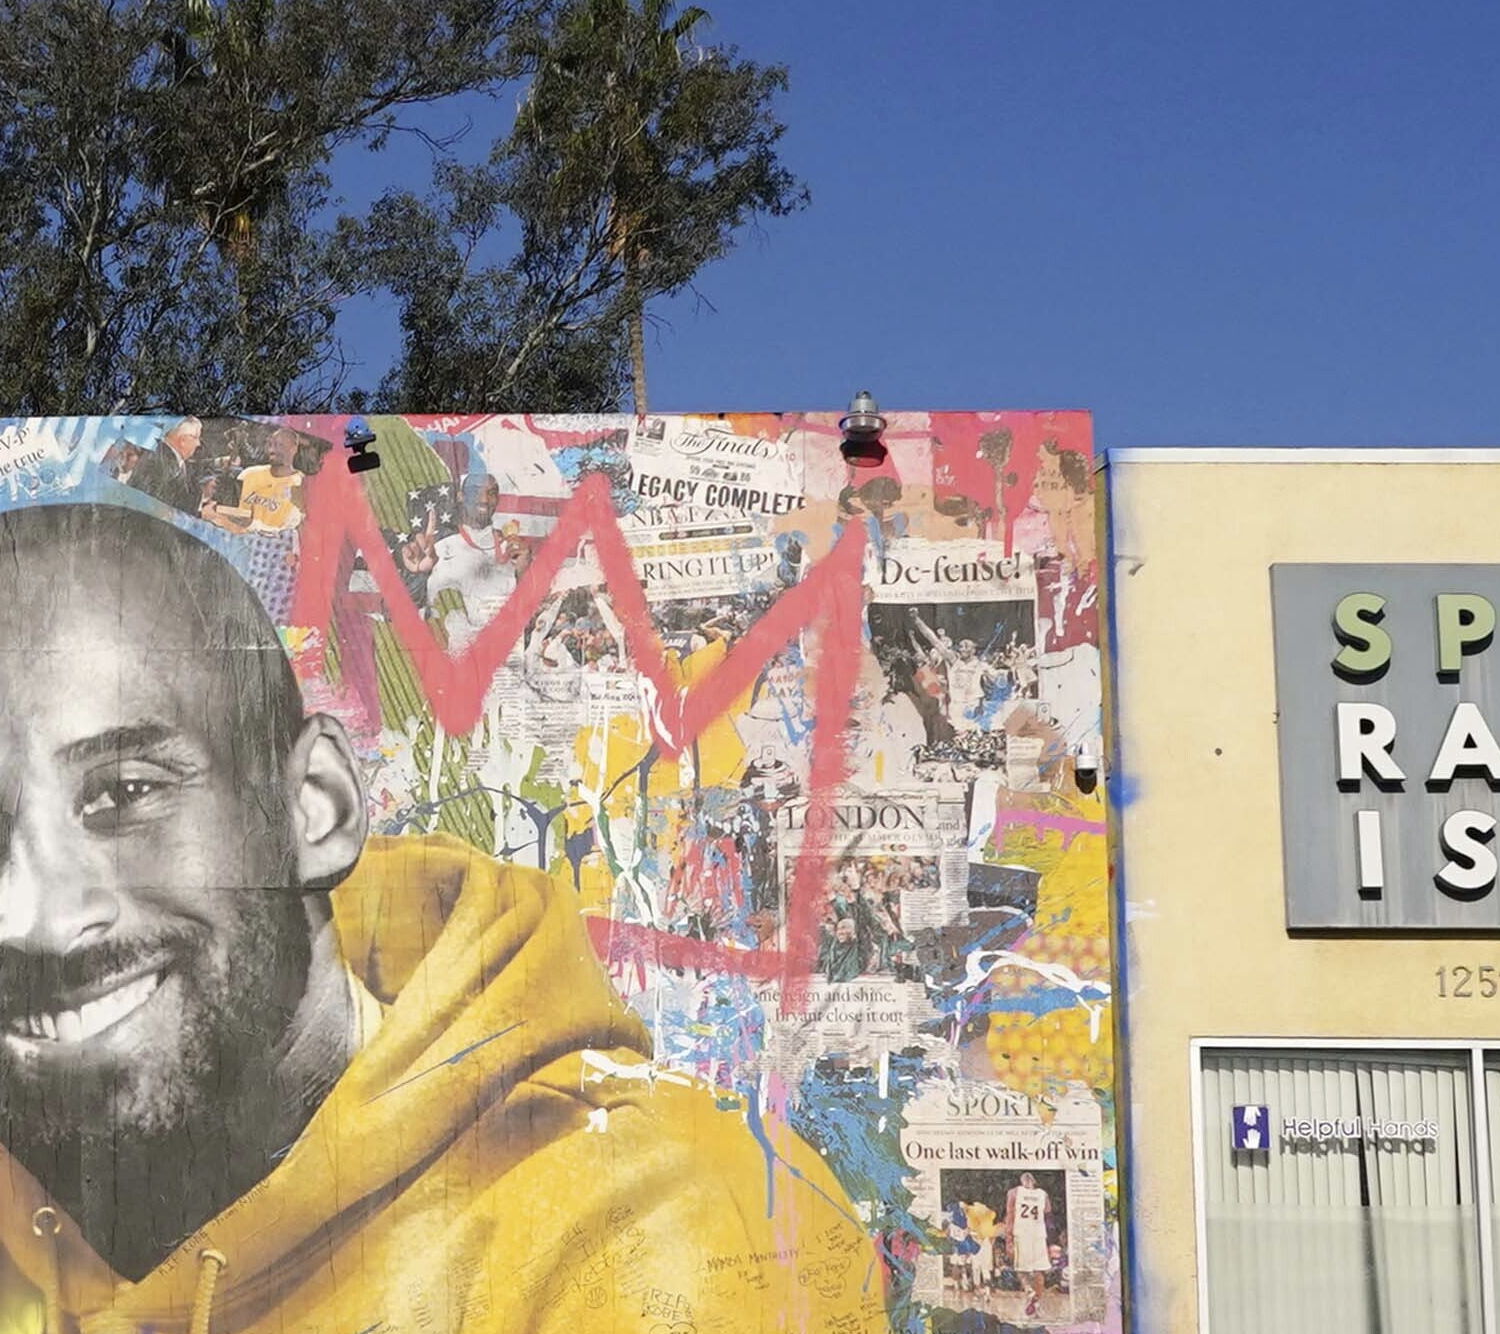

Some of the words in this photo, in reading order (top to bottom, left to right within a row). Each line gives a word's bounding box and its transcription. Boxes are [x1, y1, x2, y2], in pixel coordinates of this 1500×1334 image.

[642, 554, 702, 582] RING
[709, 555, 732, 574] IT
[880, 551, 1022, 585] De-fense!
[785, 805, 926, 831] LONDON
[826, 1007, 863, 1024] close
[867, 1007, 876, 1023] it
[1282, 1117, 1362, 1141] Helpful
[1367, 1119, 1440, 1139] Hands
[906, 1139, 946, 1160] One
[949, 1142, 981, 1160] last
[985, 1140, 1064, 1161] walk-off
[1065, 1141, 1099, 1160] win
[1020, 1203, 1039, 1220] 24
